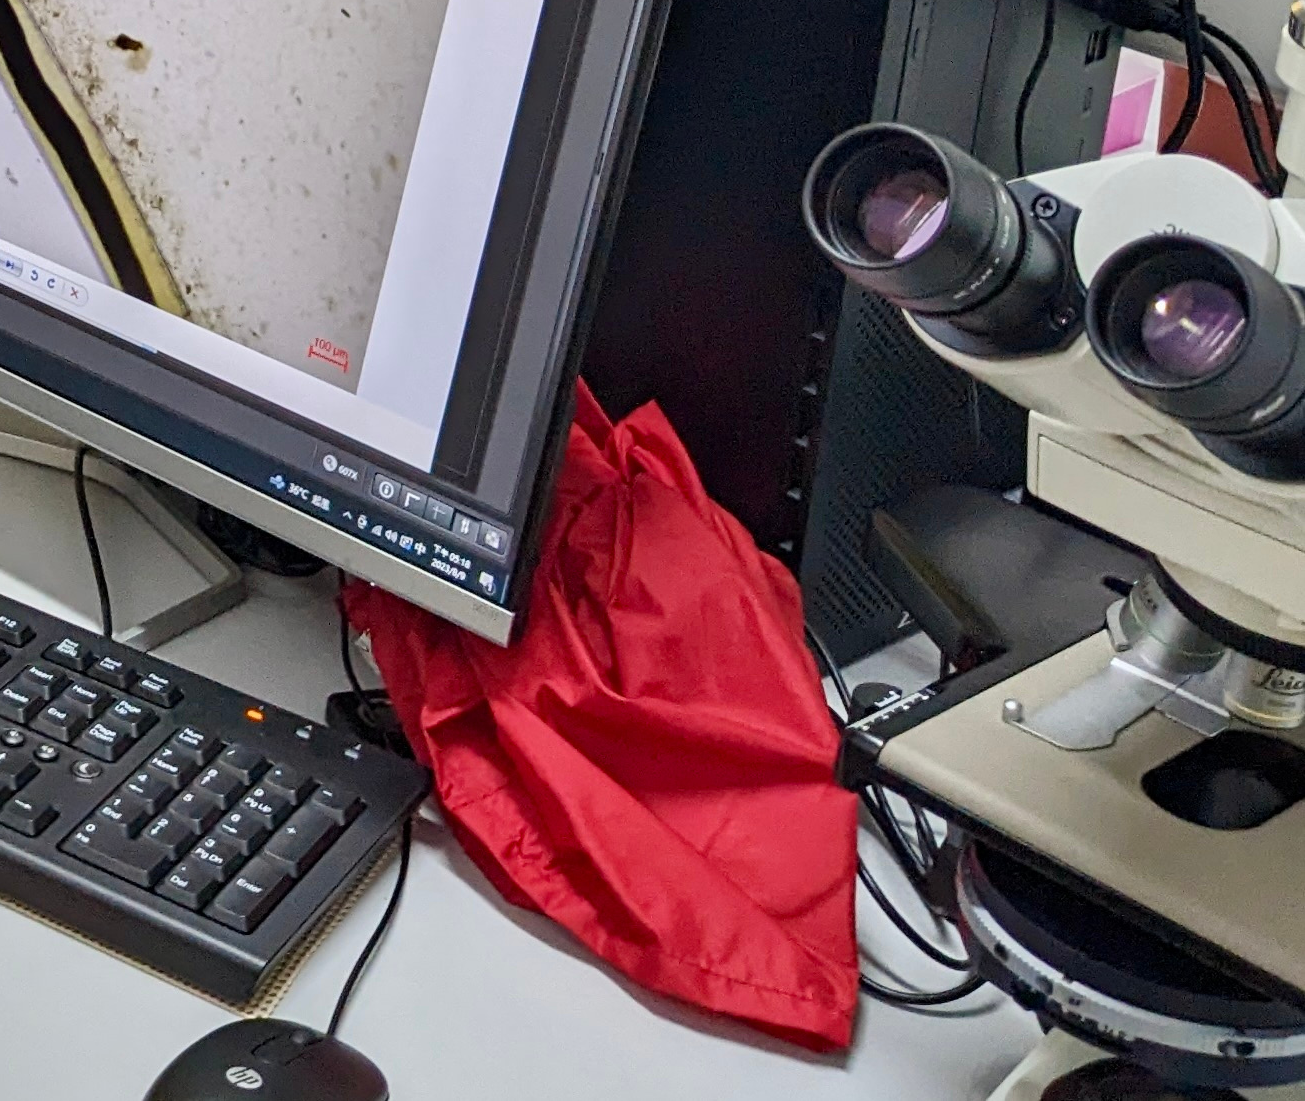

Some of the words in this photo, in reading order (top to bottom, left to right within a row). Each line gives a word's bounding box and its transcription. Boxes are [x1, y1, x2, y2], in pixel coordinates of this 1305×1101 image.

[315, 337, 332, 353] 100
[29, 666, 54, 681] Insert
[1251, 667, 1305, 696] Leic
[72, 684, 98, 699] Home
[47, 707, 67, 720] End
[120, 700, 142, 714] Page
[94, 723, 117, 737] Page
[183, 727, 204, 741] Num
[178, 733, 199, 746] Lock
[151, 757, 179, 773] Home
[101, 806, 123, 820] End
[258, 802, 272, 814] Up
[194, 847, 209, 860] Pg
[208, 853, 224, 865] Dn
[170, 874, 189, 888] Del
[236, 878, 263, 893] Enter
[226, 1066, 263, 1090] hp
